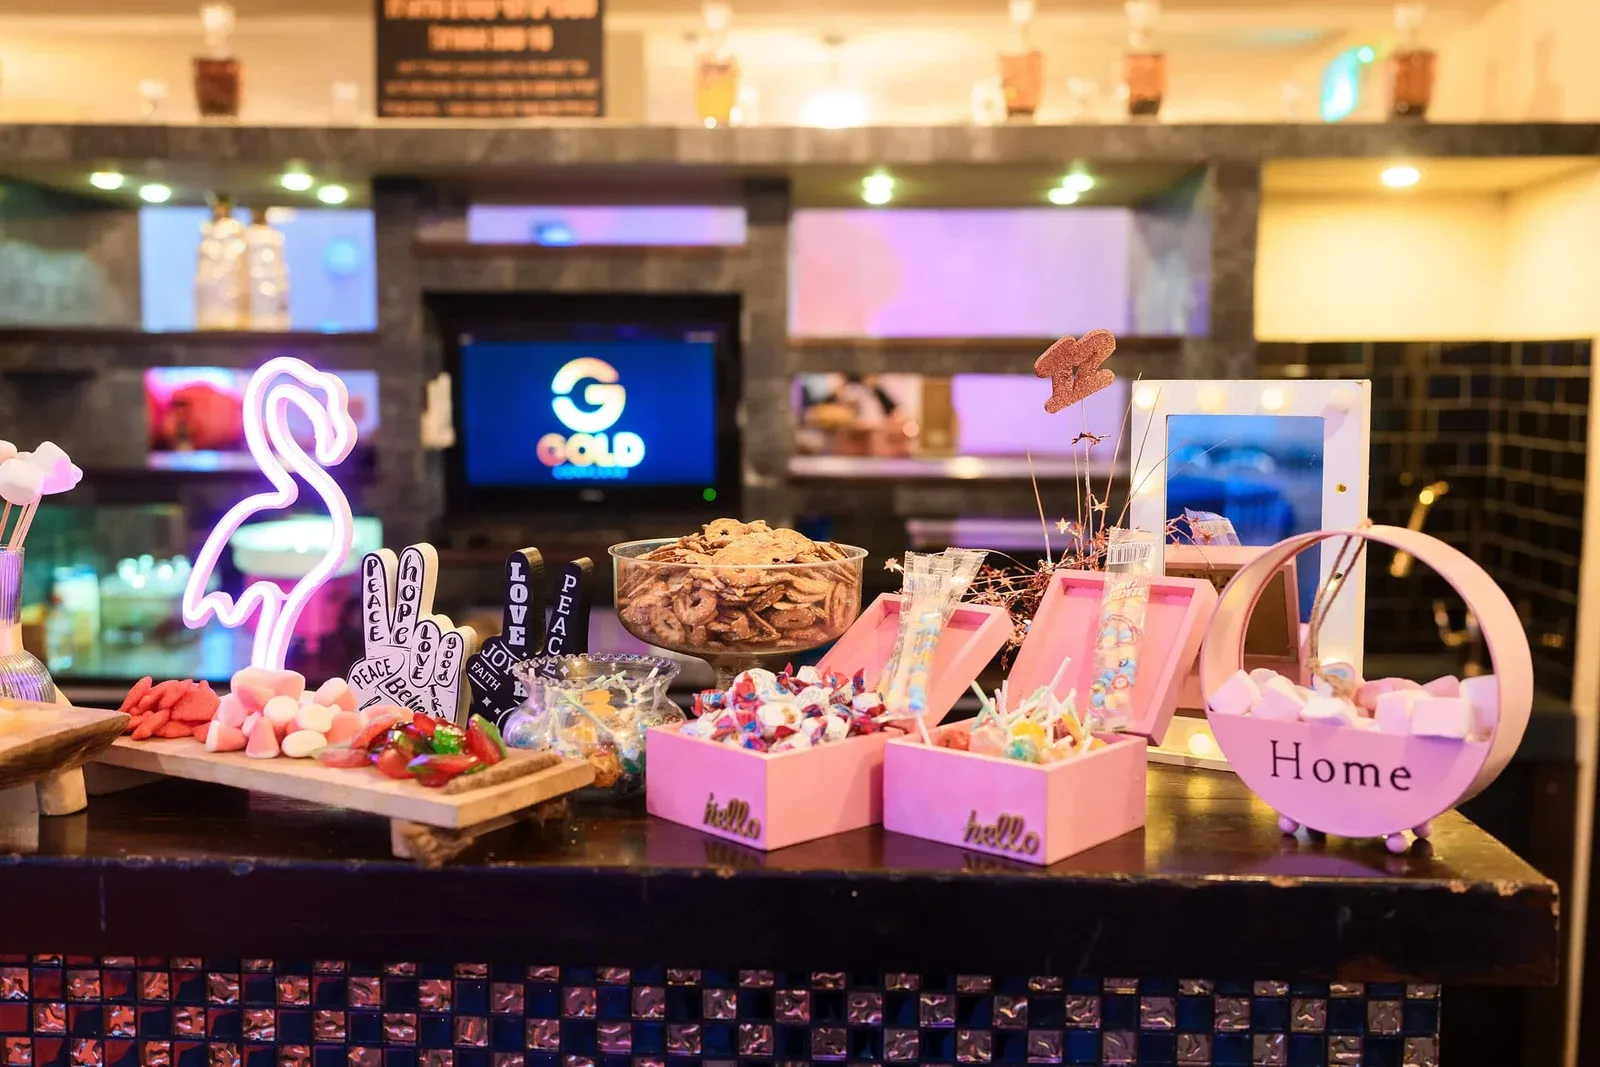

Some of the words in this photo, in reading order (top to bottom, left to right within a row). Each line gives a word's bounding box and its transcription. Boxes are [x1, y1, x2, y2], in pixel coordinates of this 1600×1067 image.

[366, 558, 384, 642] PEACE
[508, 561, 529, 647] LOVE
[351, 658, 393, 690] PEACE
[411, 624, 432, 680] LOVE
[470, 661, 501, 691] FAITH
[1269, 739, 1412, 792] Home
[702, 791, 762, 840] hello
[963, 808, 1040, 856] hello
